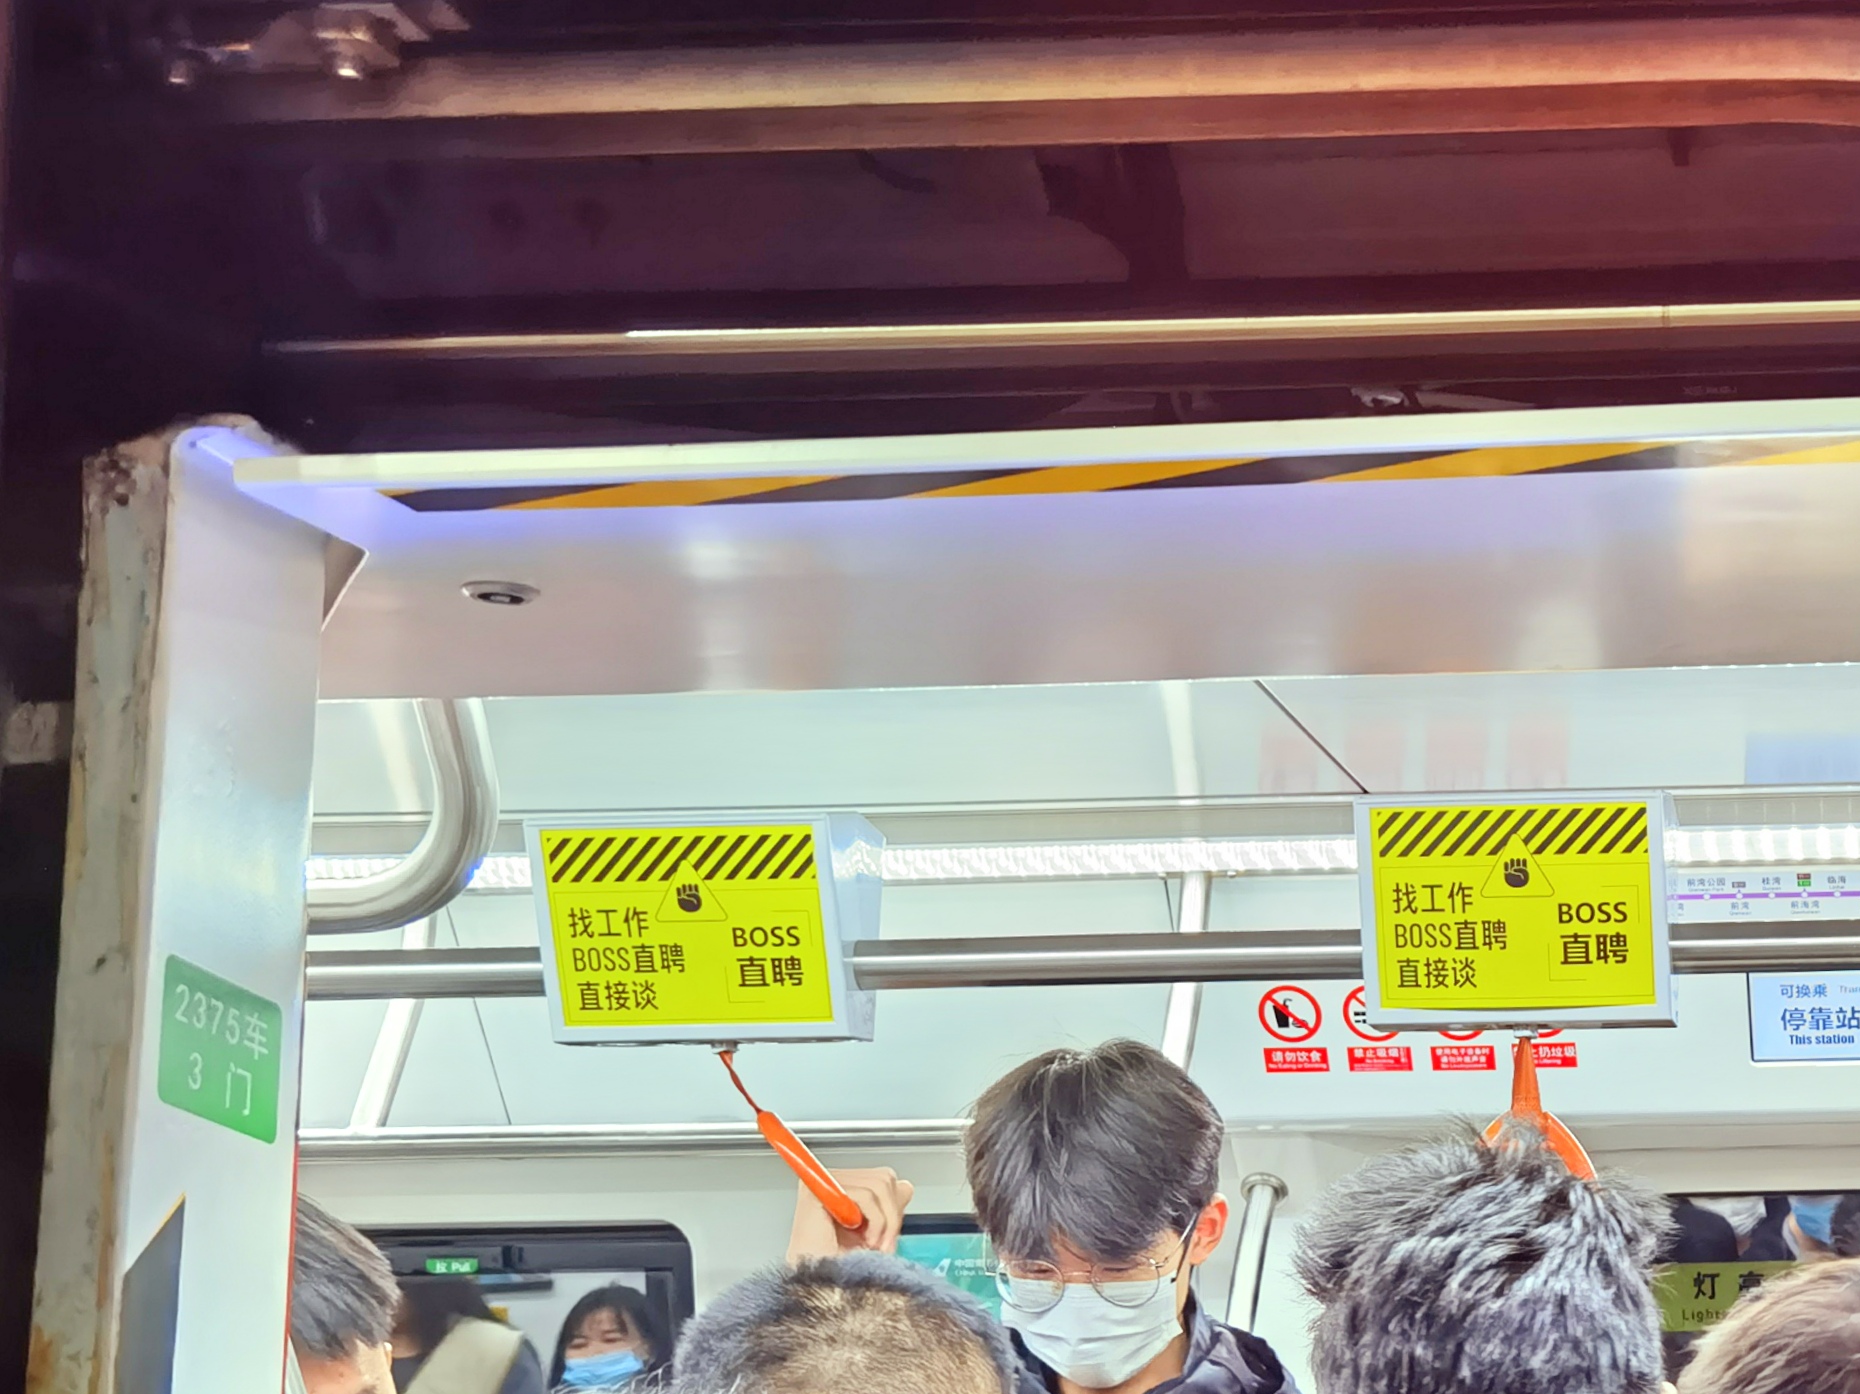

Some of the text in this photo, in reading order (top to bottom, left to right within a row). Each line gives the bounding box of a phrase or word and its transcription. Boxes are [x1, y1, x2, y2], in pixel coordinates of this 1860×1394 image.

[1392, 881, 1474, 914] 找工作
[1557, 902, 1628, 924] BOSS
[567, 907, 650, 938] 找工作
[731, 926, 801, 948] BOSS
[1394, 919, 1507, 951] BOSS直聘
[573, 943, 686, 974] BOSS直聘
[1559, 932, 1630, 965] 直聘
[736, 955, 805, 988] 直聘
[1397, 957, 1478, 989] 直接谈
[577, 980, 659, 1011] 直接谈
[1779, 984, 1828, 999] 可换乘
[174, 983, 269, 1061] 2375车
[1354, 1047, 1400, 1058] 禁止吸烟
[1789, 1033, 1855, 1045] This station
[1272, 1050, 1322, 1062] 请勿饮食
[188, 1052, 252, 1116] 3 门
